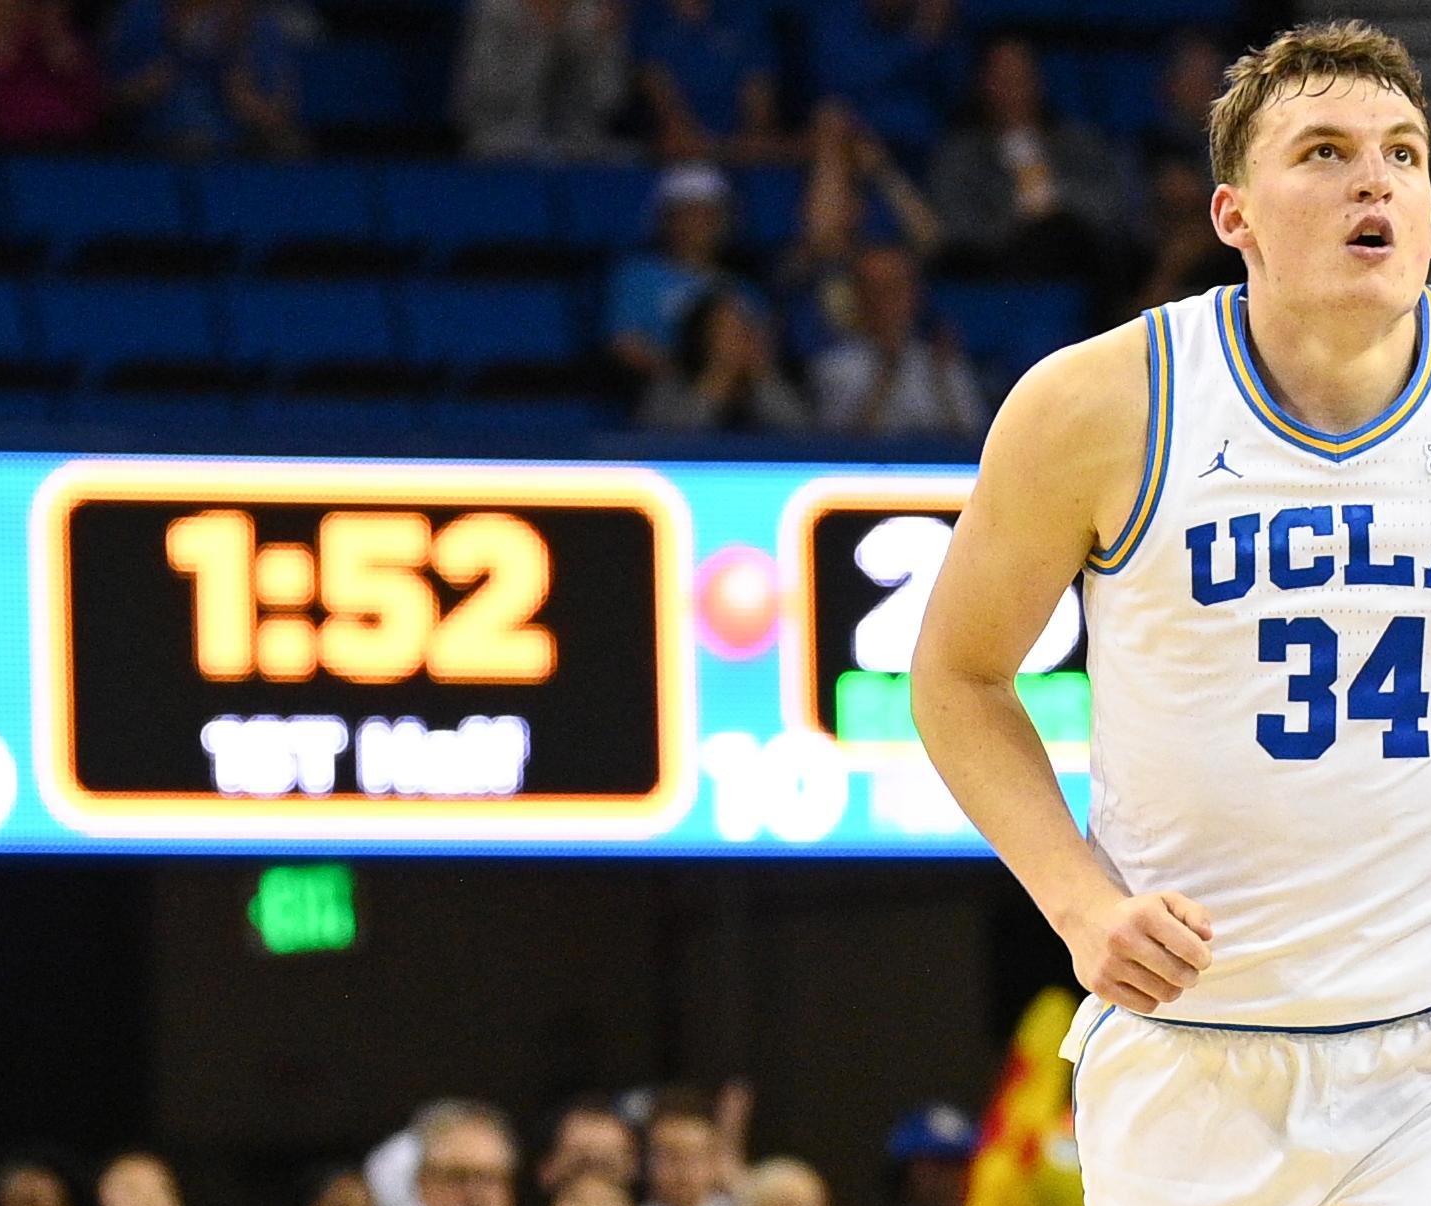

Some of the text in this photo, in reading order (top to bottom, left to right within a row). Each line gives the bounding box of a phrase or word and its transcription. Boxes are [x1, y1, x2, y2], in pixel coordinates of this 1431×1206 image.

[165, 508, 558, 684] 1:52
[1255, 615, 1431, 761] 34
[702, 732, 849, 843] 10
